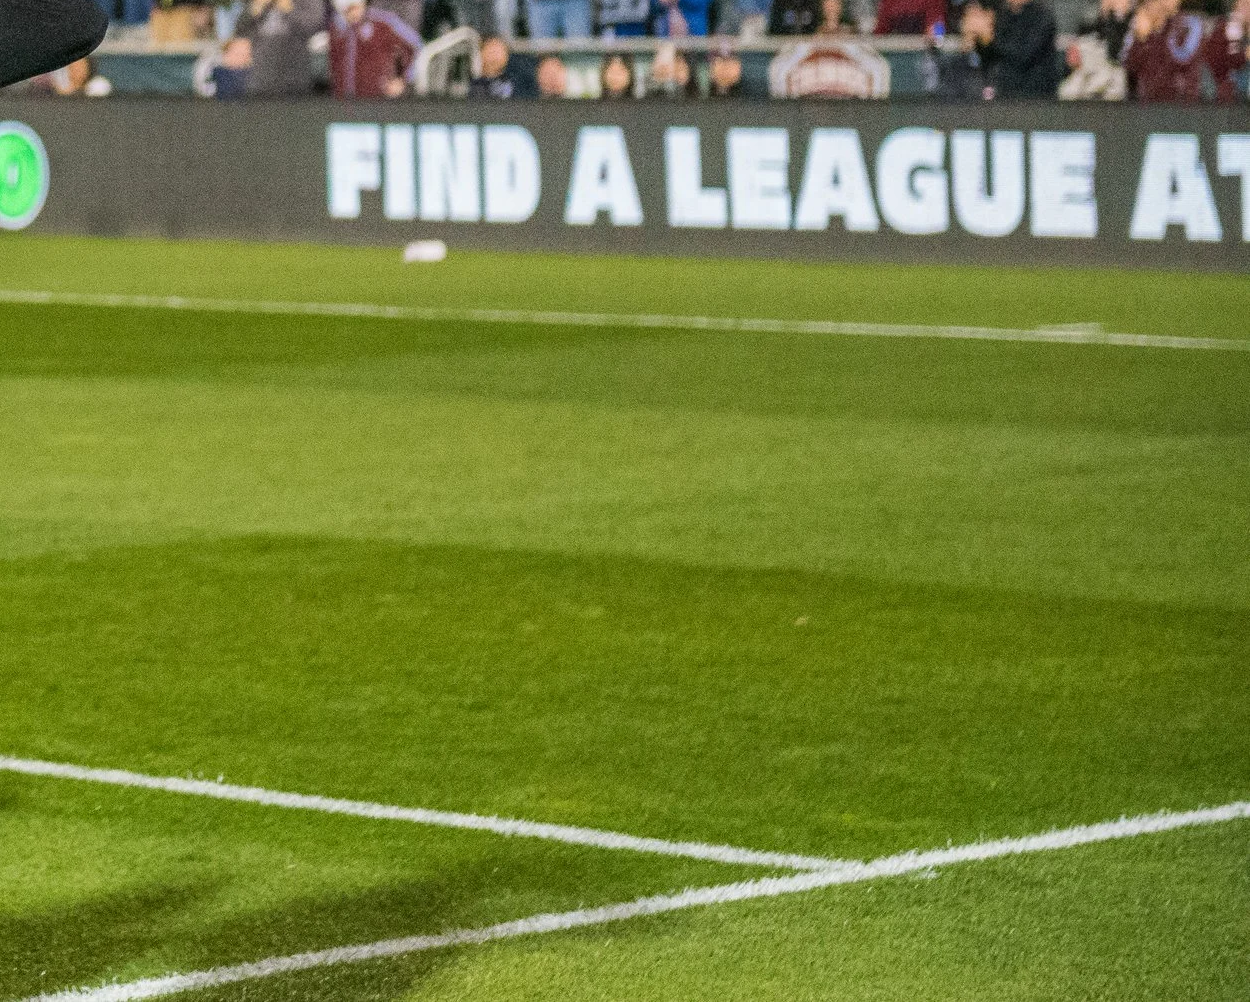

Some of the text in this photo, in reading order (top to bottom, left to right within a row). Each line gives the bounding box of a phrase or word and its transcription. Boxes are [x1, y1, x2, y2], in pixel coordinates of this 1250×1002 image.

[325, 121, 541, 223] FIND
[564, 124, 644, 227] A
[663, 126, 1099, 239] LEAGUE
